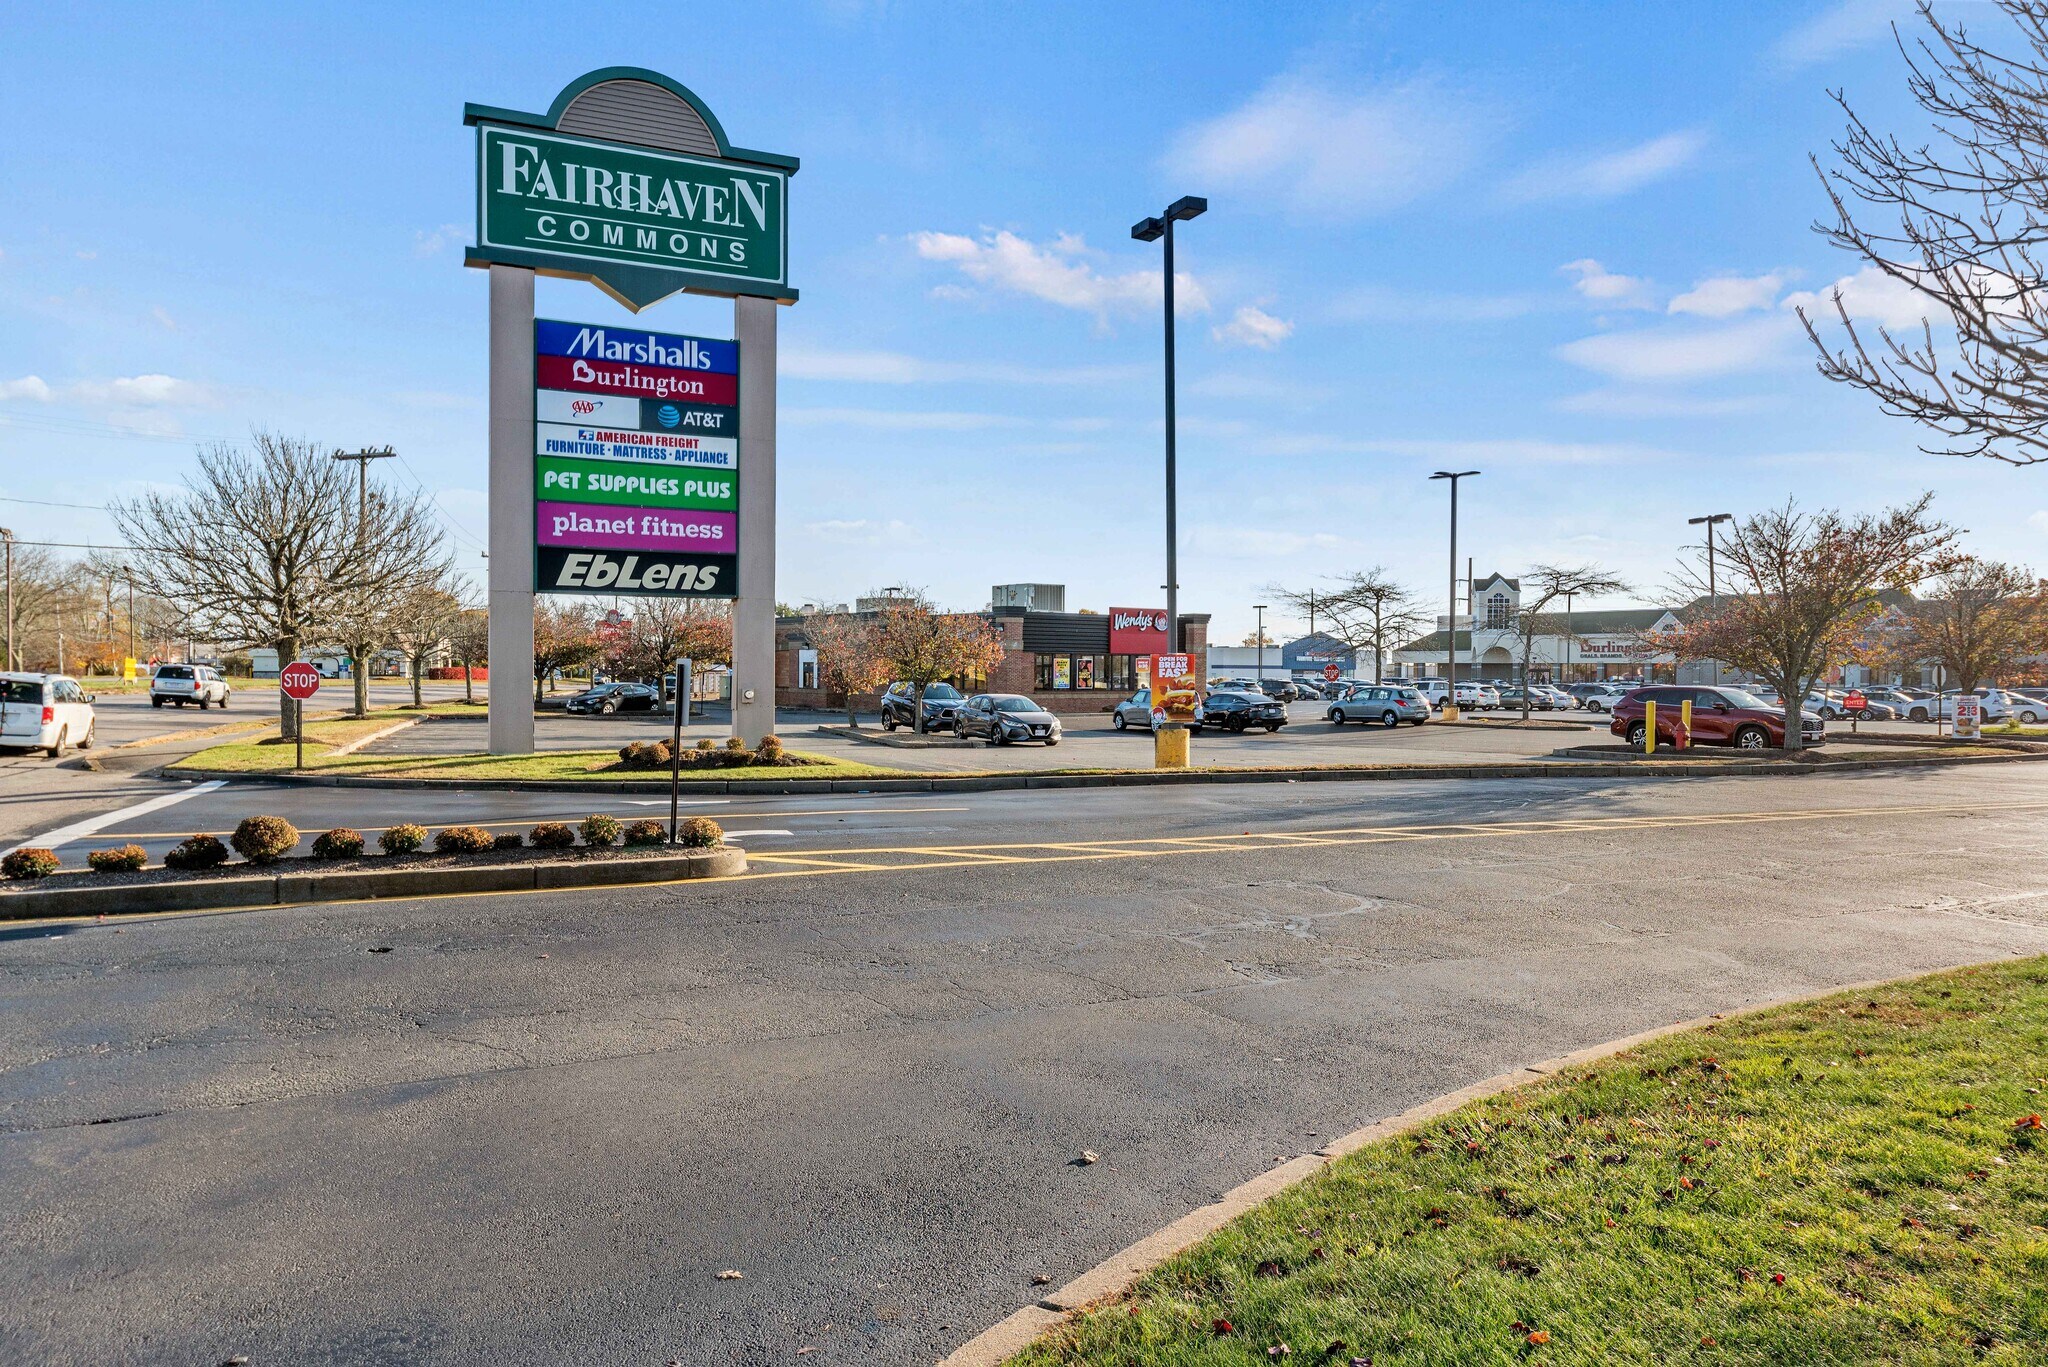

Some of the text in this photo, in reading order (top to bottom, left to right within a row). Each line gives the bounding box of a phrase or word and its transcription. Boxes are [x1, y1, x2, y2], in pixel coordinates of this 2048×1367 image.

[497, 141, 770, 231] FAIRHAVEN
[537, 215, 747, 262] COMMONS
[566, 328, 711, 370] Marshalls
[572, 359, 705, 398] Burlington
[573, 400, 593, 413] AAA
[683, 411, 724, 428] AT&T
[596, 431, 653, 446] AMERICAN
[655, 436, 700, 449] FREIGHT
[546, 439, 729, 465] FURNITURE MATTRESS APPLIANCE
[544, 470, 731, 499] PET SUPPLIES PLUS
[552, 512, 723, 539] planet fitness
[555, 553, 720, 591] EbLens
[1114, 610, 1153, 631] Wendy's
[1159, 661, 1188, 669] BREAK
[1159, 668, 1188, 678] FAST
[1325, 669, 1339, 678] STOP
[284, 673, 317, 688] STOP
[1957, 706, 1967, 716] 2
